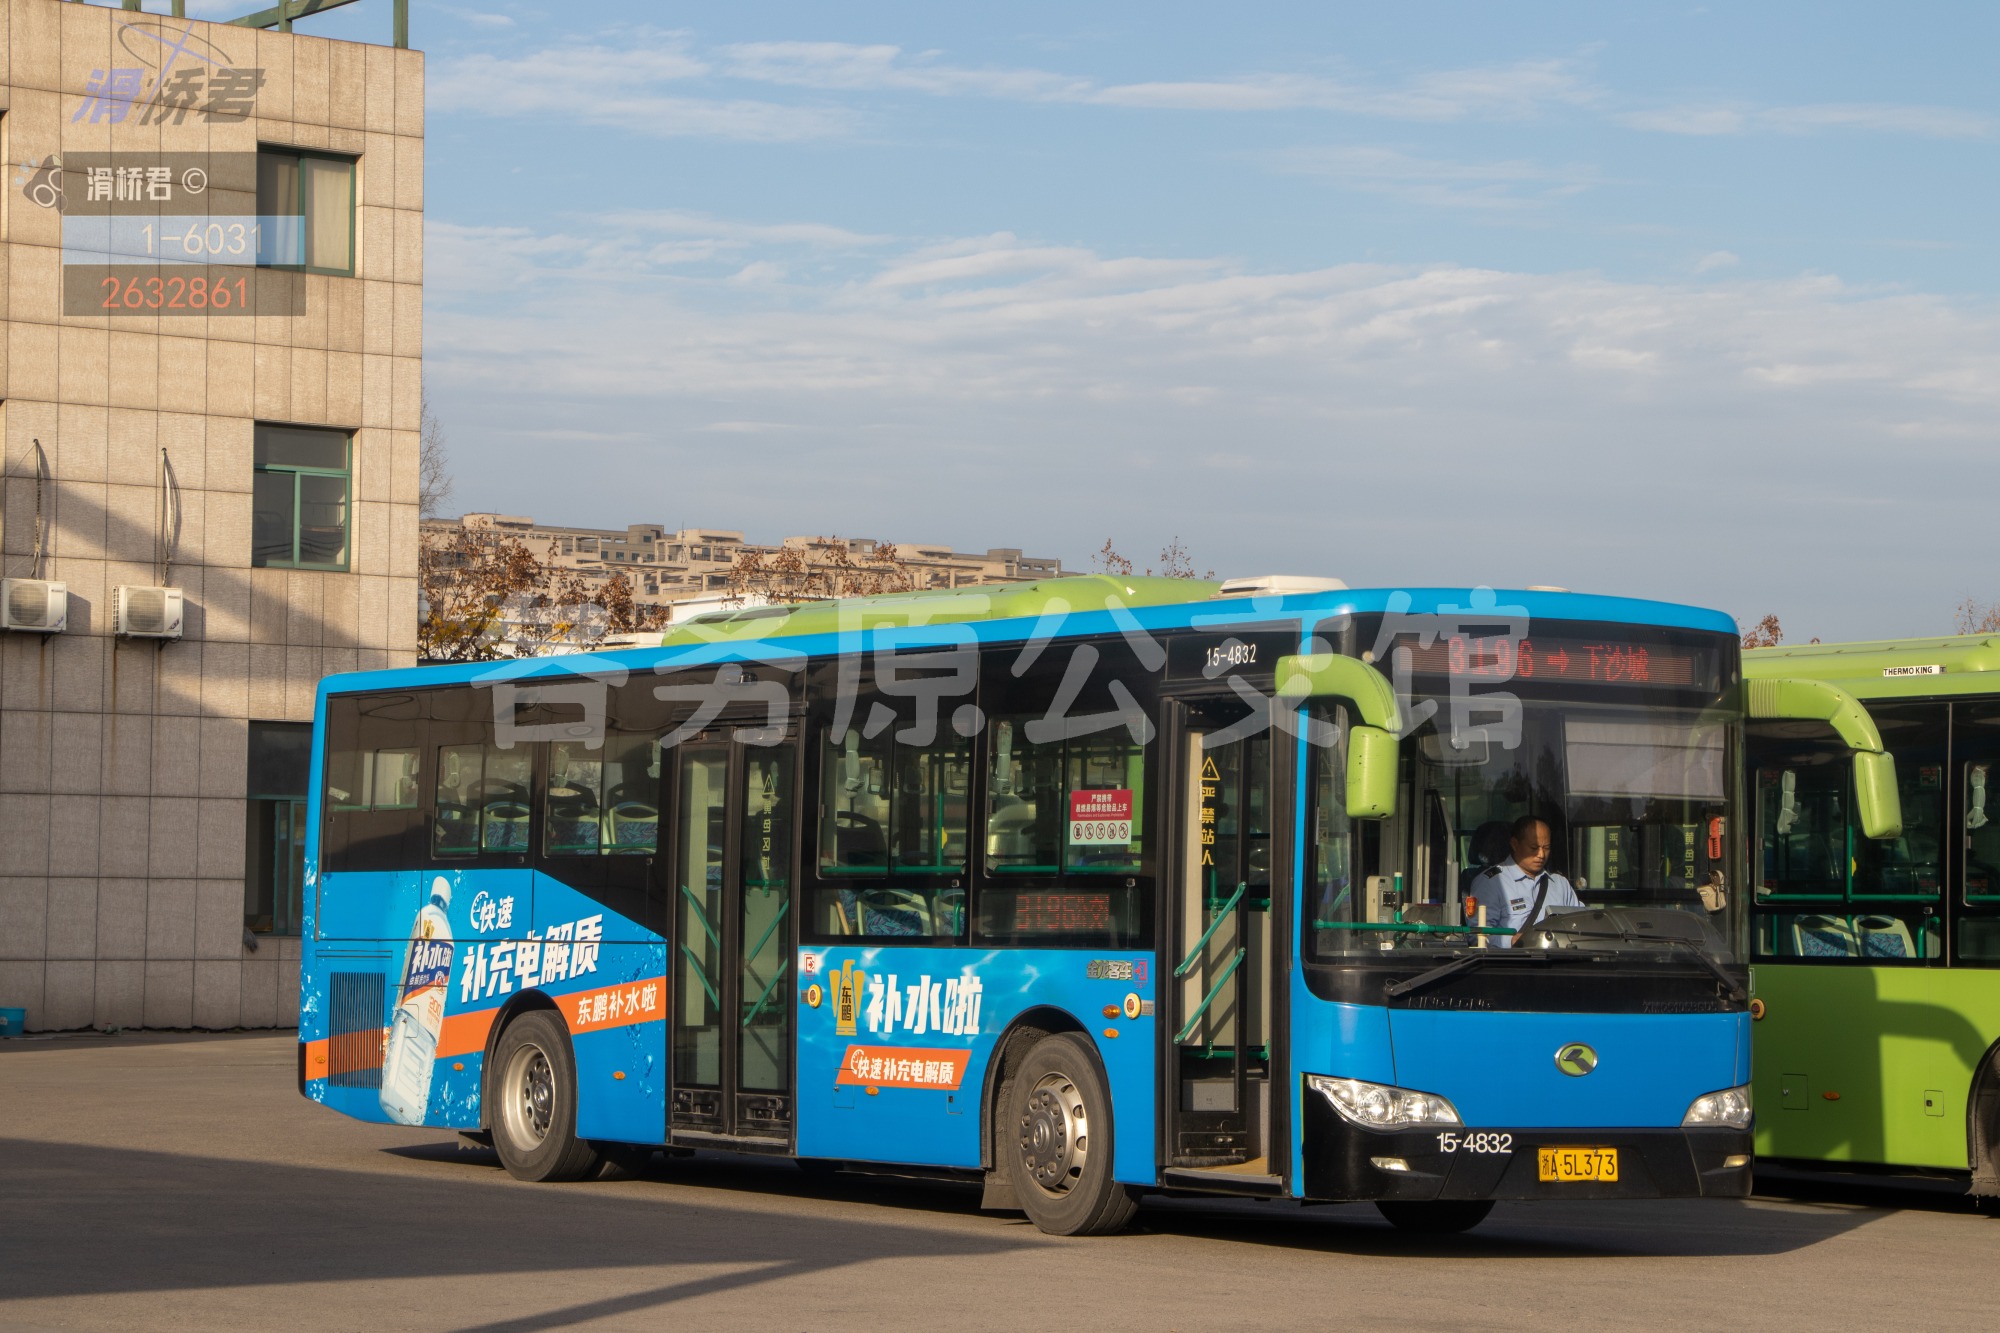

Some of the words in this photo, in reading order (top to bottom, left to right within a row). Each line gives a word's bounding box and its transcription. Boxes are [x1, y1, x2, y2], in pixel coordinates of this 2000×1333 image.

[1206, 644, 1257, 667] 15-4832
[1449, 637, 1534, 677] 3196
[1883, 667, 1914, 676] THERMO
[1915, 665, 1933, 674] KING
[1200, 786, 1215, 866] 严禁站人
[479, 895, 514, 933] 快速
[412, 940, 453, 975] 补水啦
[460, 913, 603, 1004] 补充电解质
[1086, 959, 1134, 981] 金龙客车
[576, 984, 657, 1026] 东鹏补水啦
[841, 985, 852, 1022] 东鹏
[866, 973, 983, 1036] 补水啦
[857, 1056, 955, 1085] 快速补充电解质
[1436, 1133, 1512, 1154] 15-4832
